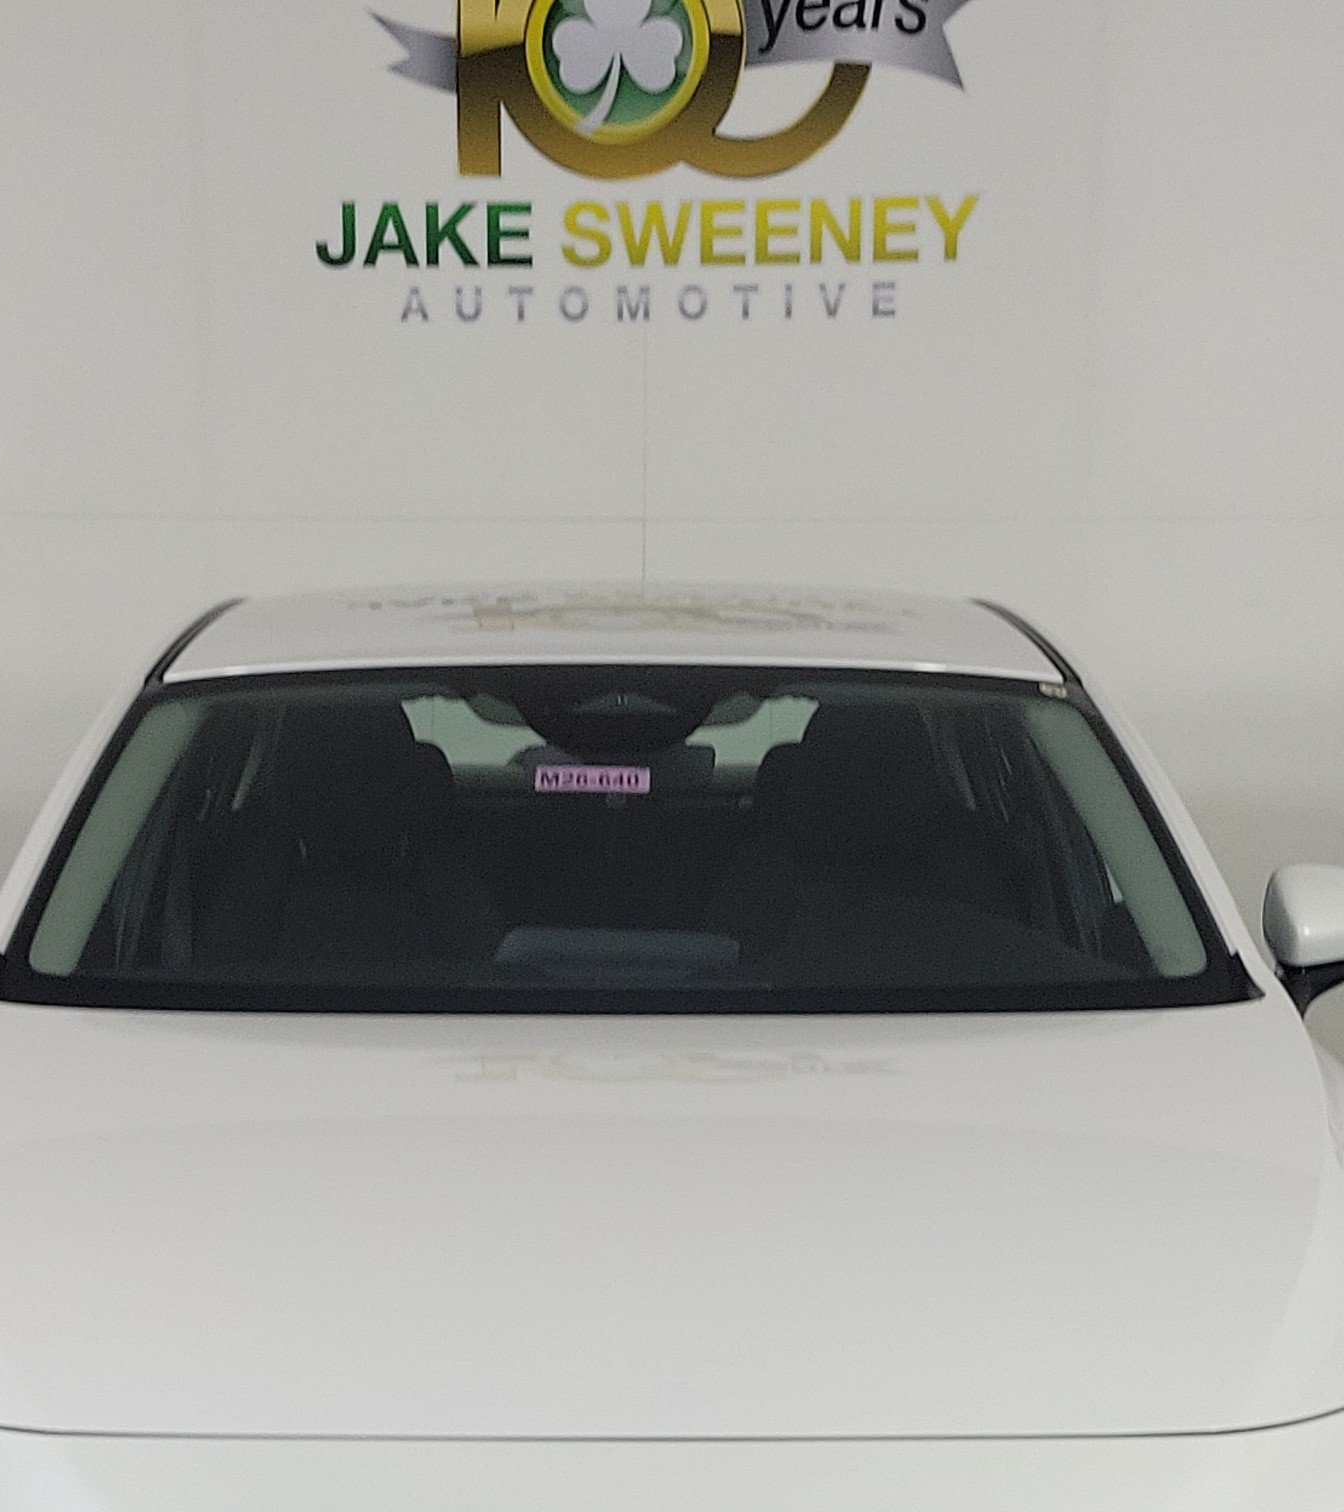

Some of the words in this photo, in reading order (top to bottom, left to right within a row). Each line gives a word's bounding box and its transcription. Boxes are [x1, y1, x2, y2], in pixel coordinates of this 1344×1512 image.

[315, 201, 533, 268] JAKE
[561, 195, 979, 269] SWEENEY
[400, 281, 898, 323] AUTOMOTIVE
